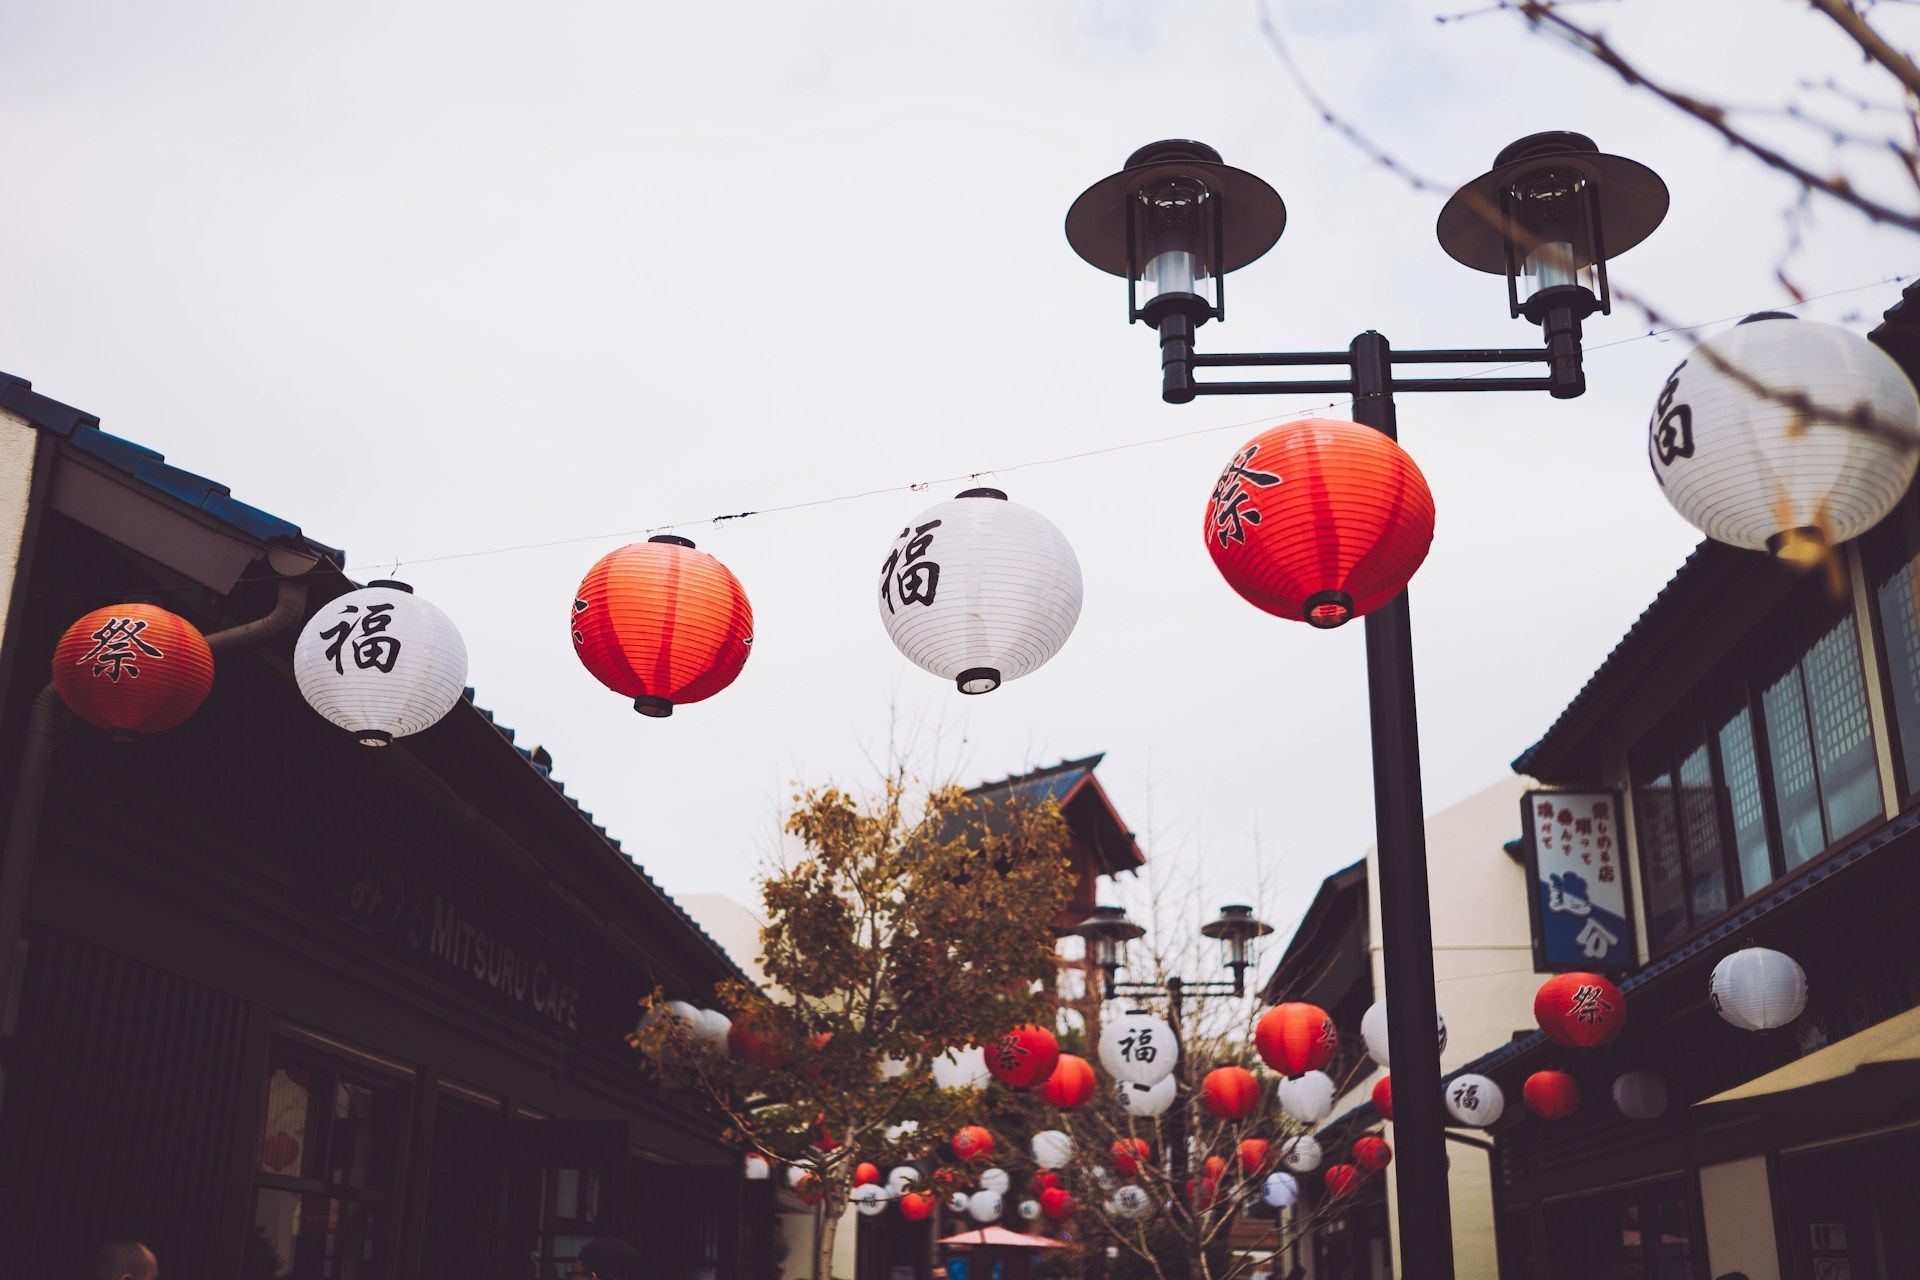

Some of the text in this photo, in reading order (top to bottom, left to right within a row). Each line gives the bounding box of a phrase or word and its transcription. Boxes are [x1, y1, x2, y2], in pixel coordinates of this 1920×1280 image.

[881, 519, 942, 615] 福
[77, 616, 164, 684] 祭
[320, 603, 402, 676] 福
[430, 893, 528, 1003] MITSURU
[532, 959, 579, 1031] CAFE
[1566, 984, 1614, 1025] 祭
[996, 1034, 1032, 1071] 祭
[1118, 1028, 1158, 1063] 福
[1452, 1083, 1480, 1111] 福
